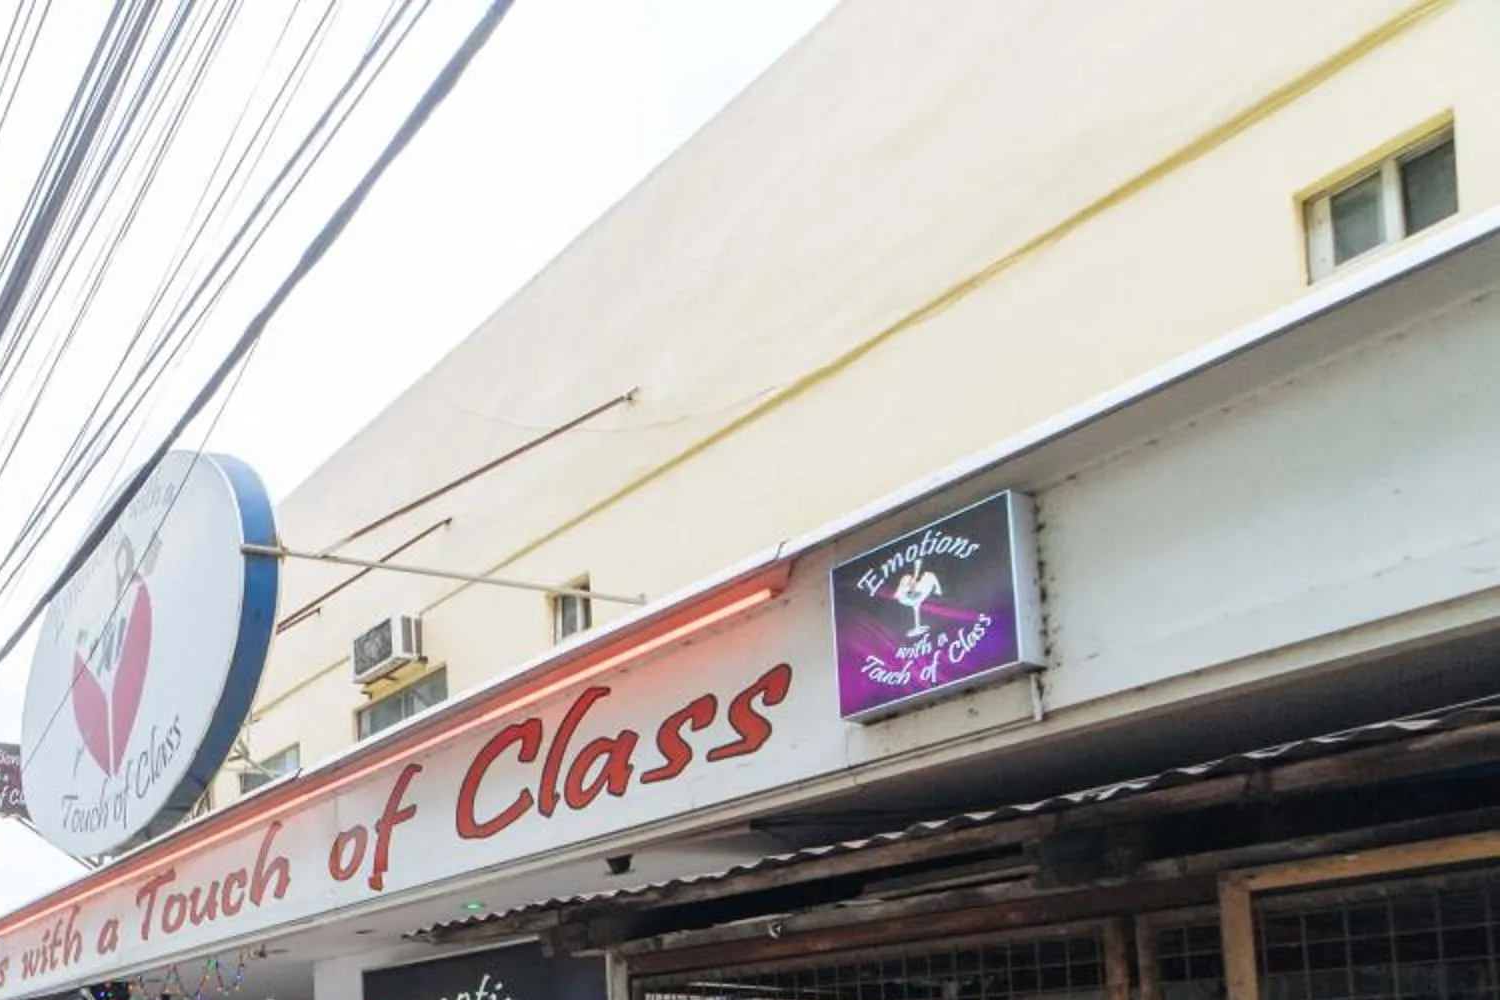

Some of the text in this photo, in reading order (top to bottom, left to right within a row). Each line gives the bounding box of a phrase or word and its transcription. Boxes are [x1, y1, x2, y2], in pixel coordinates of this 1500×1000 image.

[857, 529, 980, 597] Emotions
[860, 613, 993, 686] Touch of Class
[896, 631, 949, 659] with a
[61, 713, 182, 833] Touch of Class
[21, 905, 83, 980] with
[97, 919, 120, 956] a
[136, 821, 293, 943] Touch
[328, 762, 419, 893] of
[454, 662, 793, 841] Class
